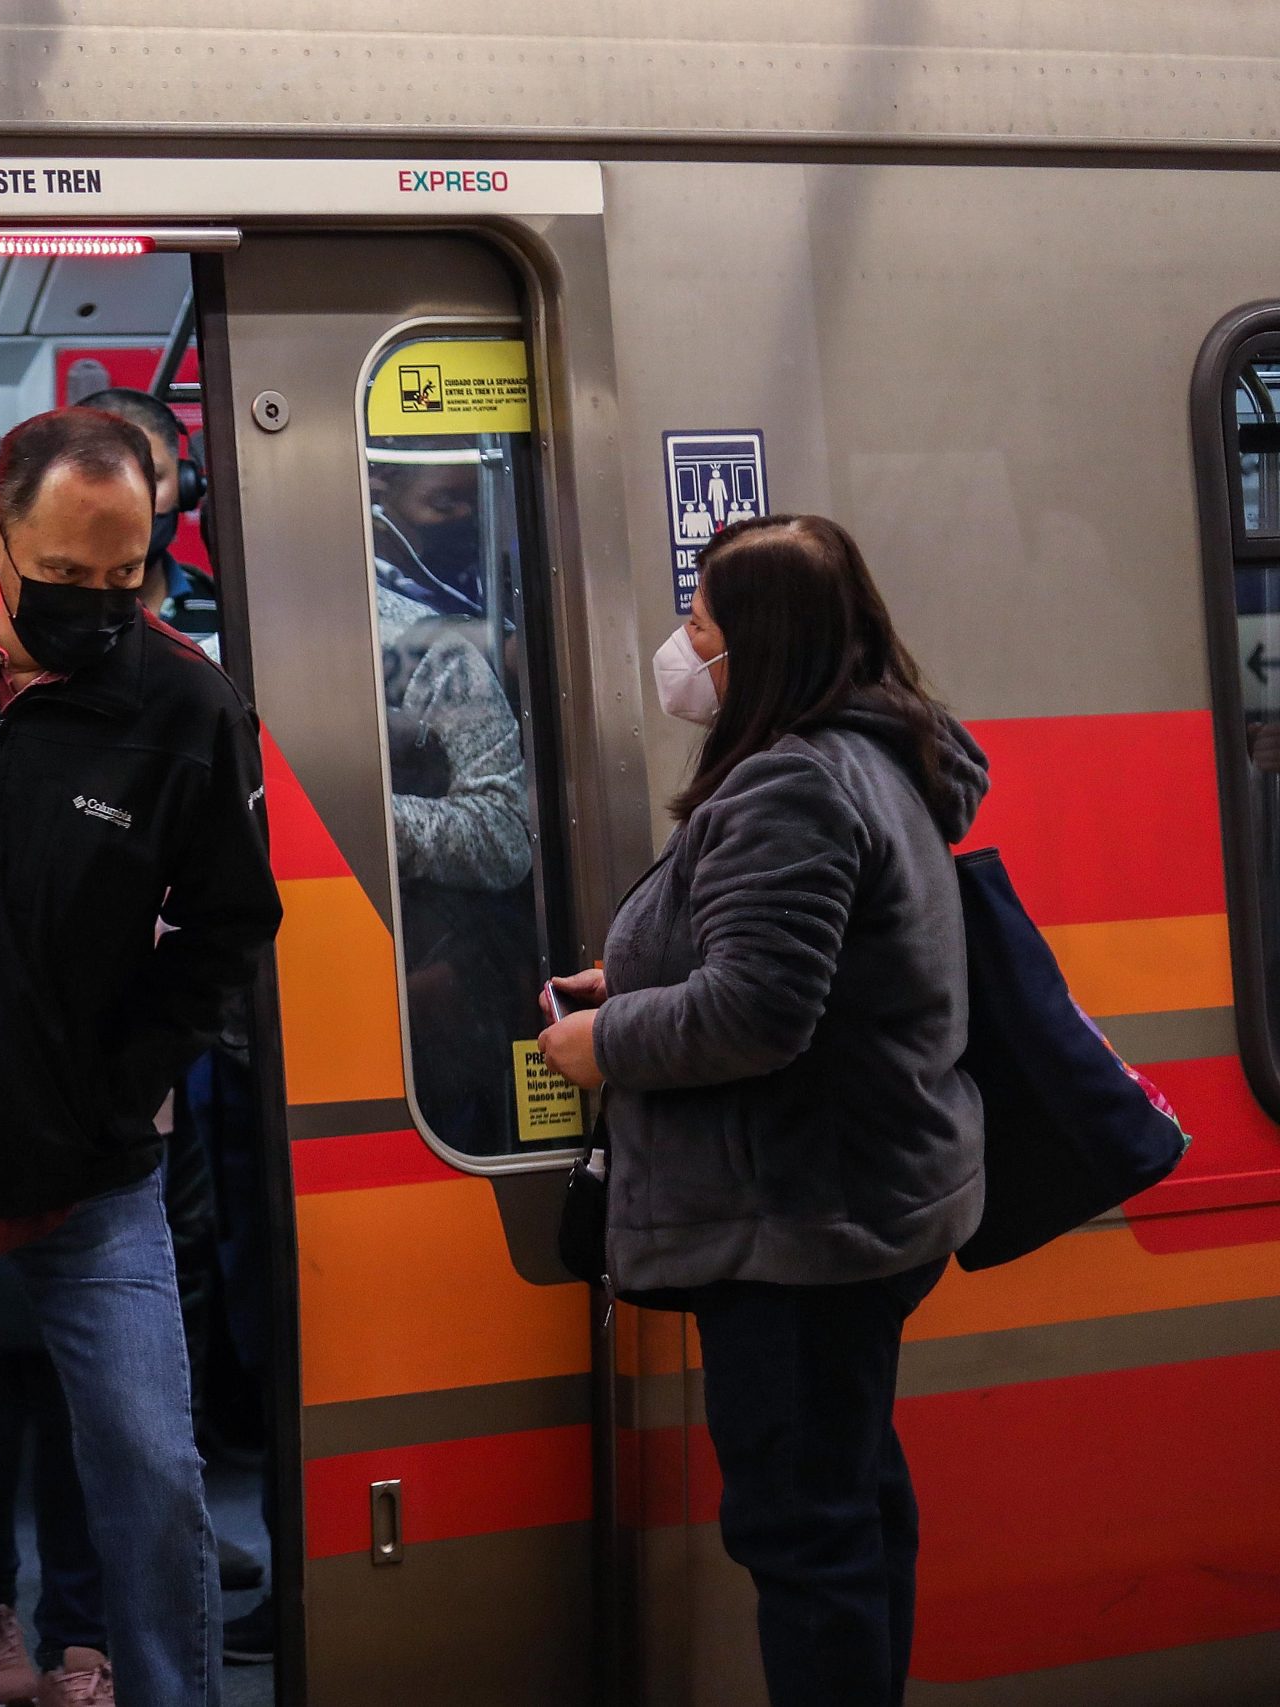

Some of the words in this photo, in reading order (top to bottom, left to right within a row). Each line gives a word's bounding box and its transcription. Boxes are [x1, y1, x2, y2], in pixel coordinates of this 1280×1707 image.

[42, 169, 102, 194] TREN
[398, 170, 509, 192] EXPRESO
[676, 549, 697, 570] DE
[678, 571, 699, 588] ant
[525, 1052, 546, 1065] PRE
[526, 1068, 537, 1078] No
